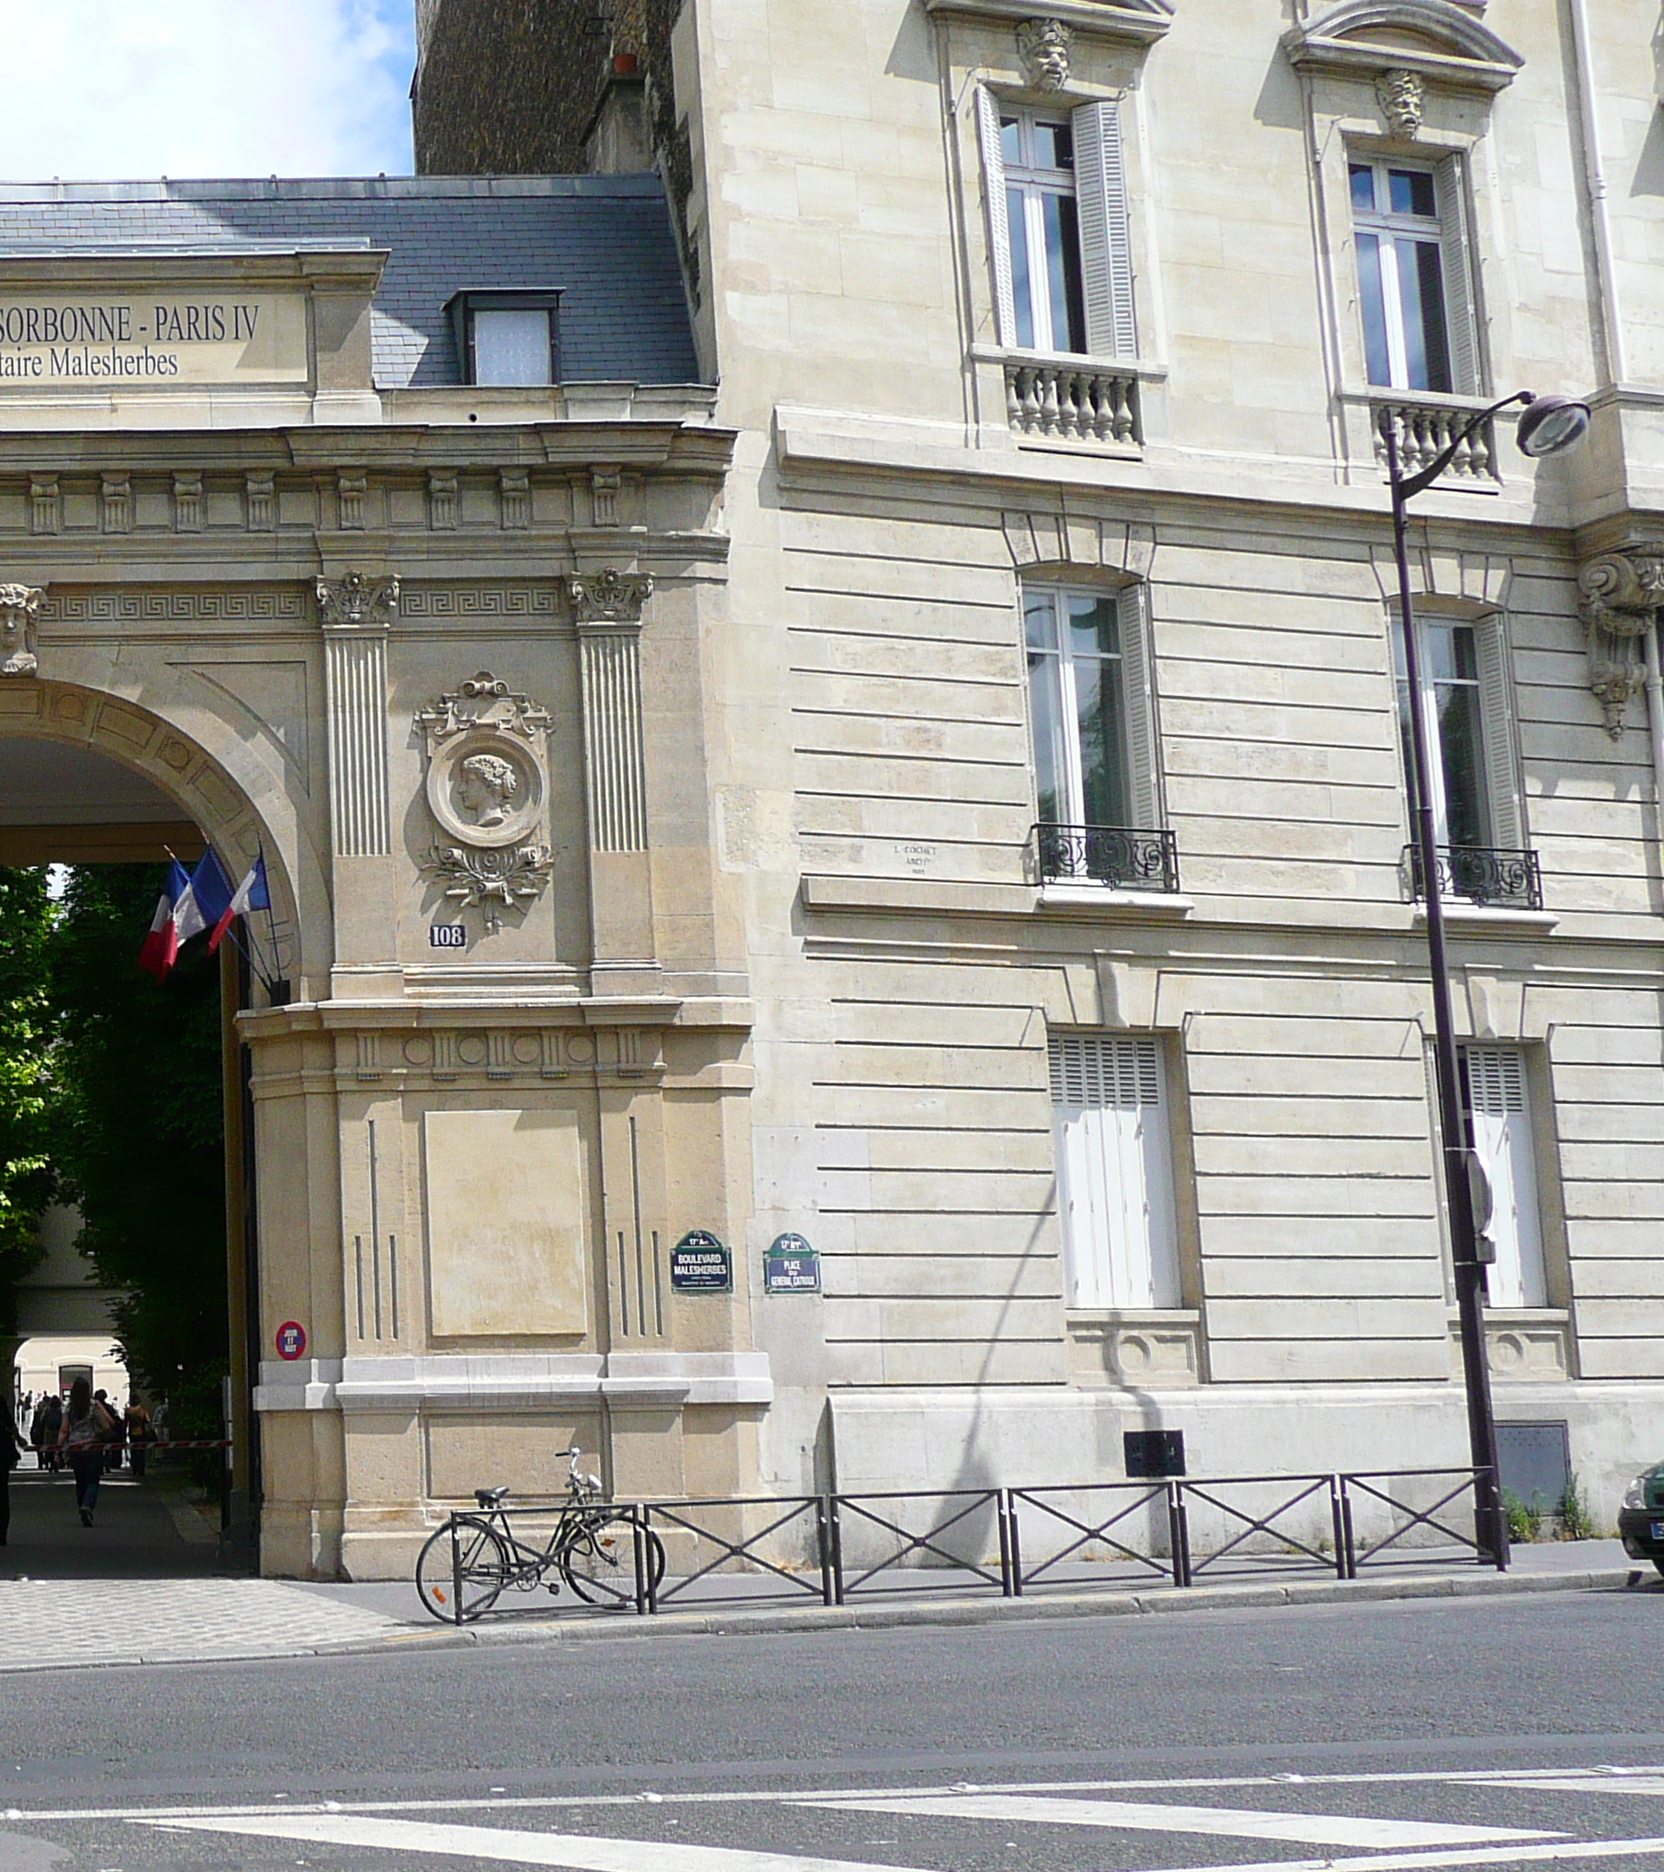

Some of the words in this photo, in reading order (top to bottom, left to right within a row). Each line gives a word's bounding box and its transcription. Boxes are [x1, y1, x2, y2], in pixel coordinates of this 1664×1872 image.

[154, 305, 225, 341] PARIS
[232, 305, 260, 341] IV
[50, 344, 178, 376] Malesherbes
[433, 926, 462, 946] 108
[677, 1254, 722, 1264] BOULEVARD
[674, 1265, 727, 1275] MALESHERBES
